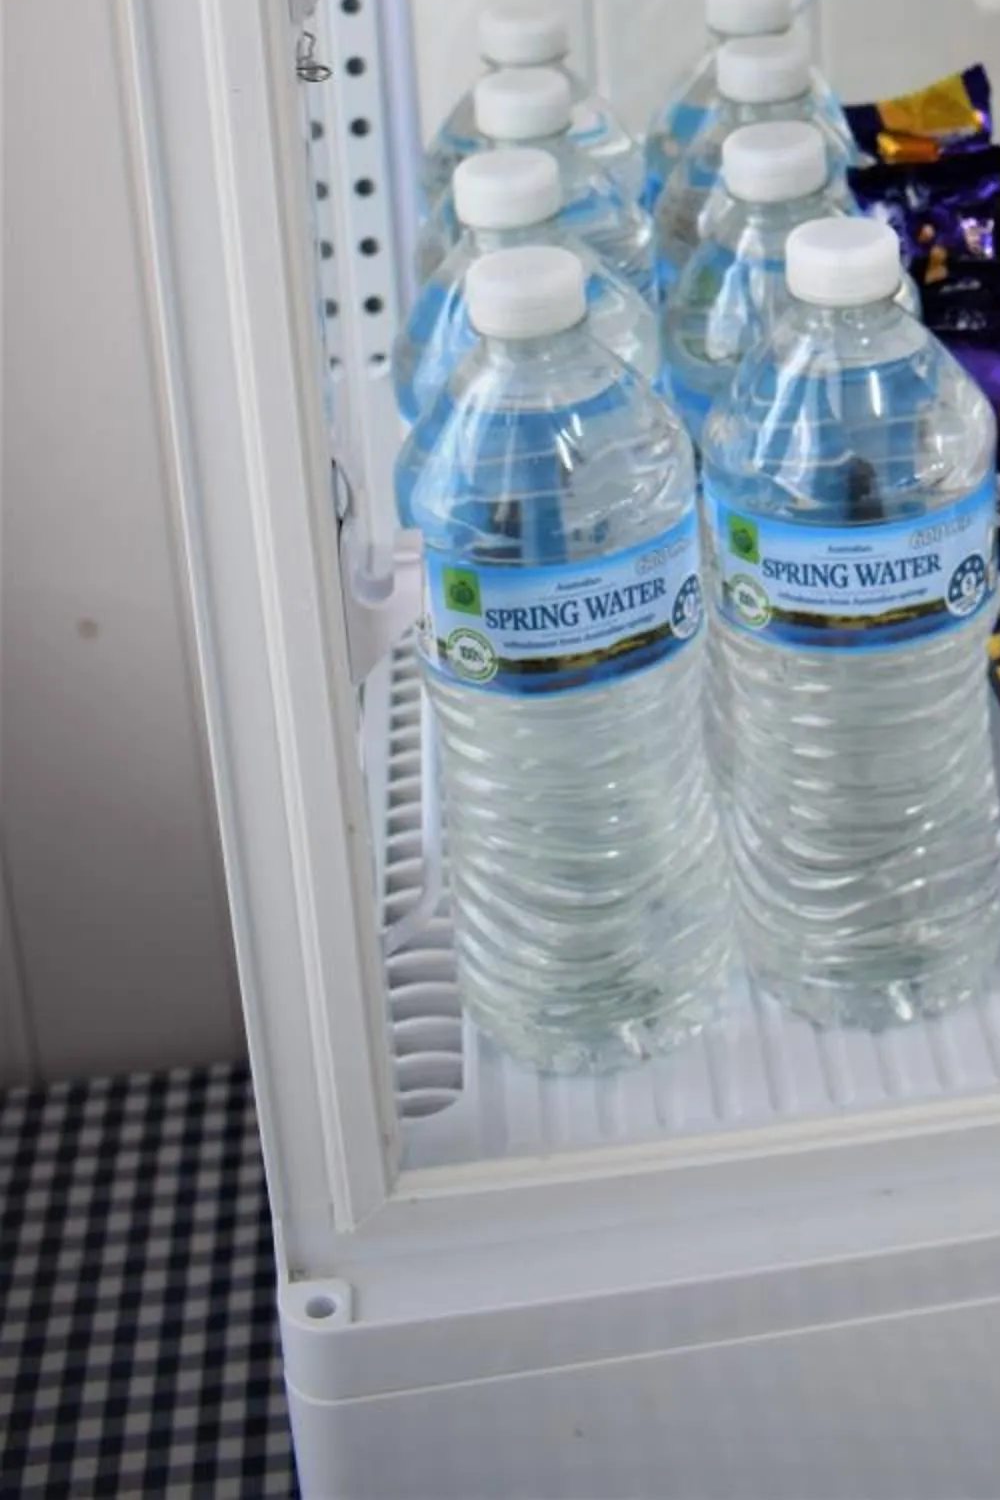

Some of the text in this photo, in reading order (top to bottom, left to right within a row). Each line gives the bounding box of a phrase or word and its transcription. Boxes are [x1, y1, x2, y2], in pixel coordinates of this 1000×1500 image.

[761, 553, 942, 589] SPRING WATER
[485, 599, 581, 632] SPRING
[582, 577, 667, 621] WATER
